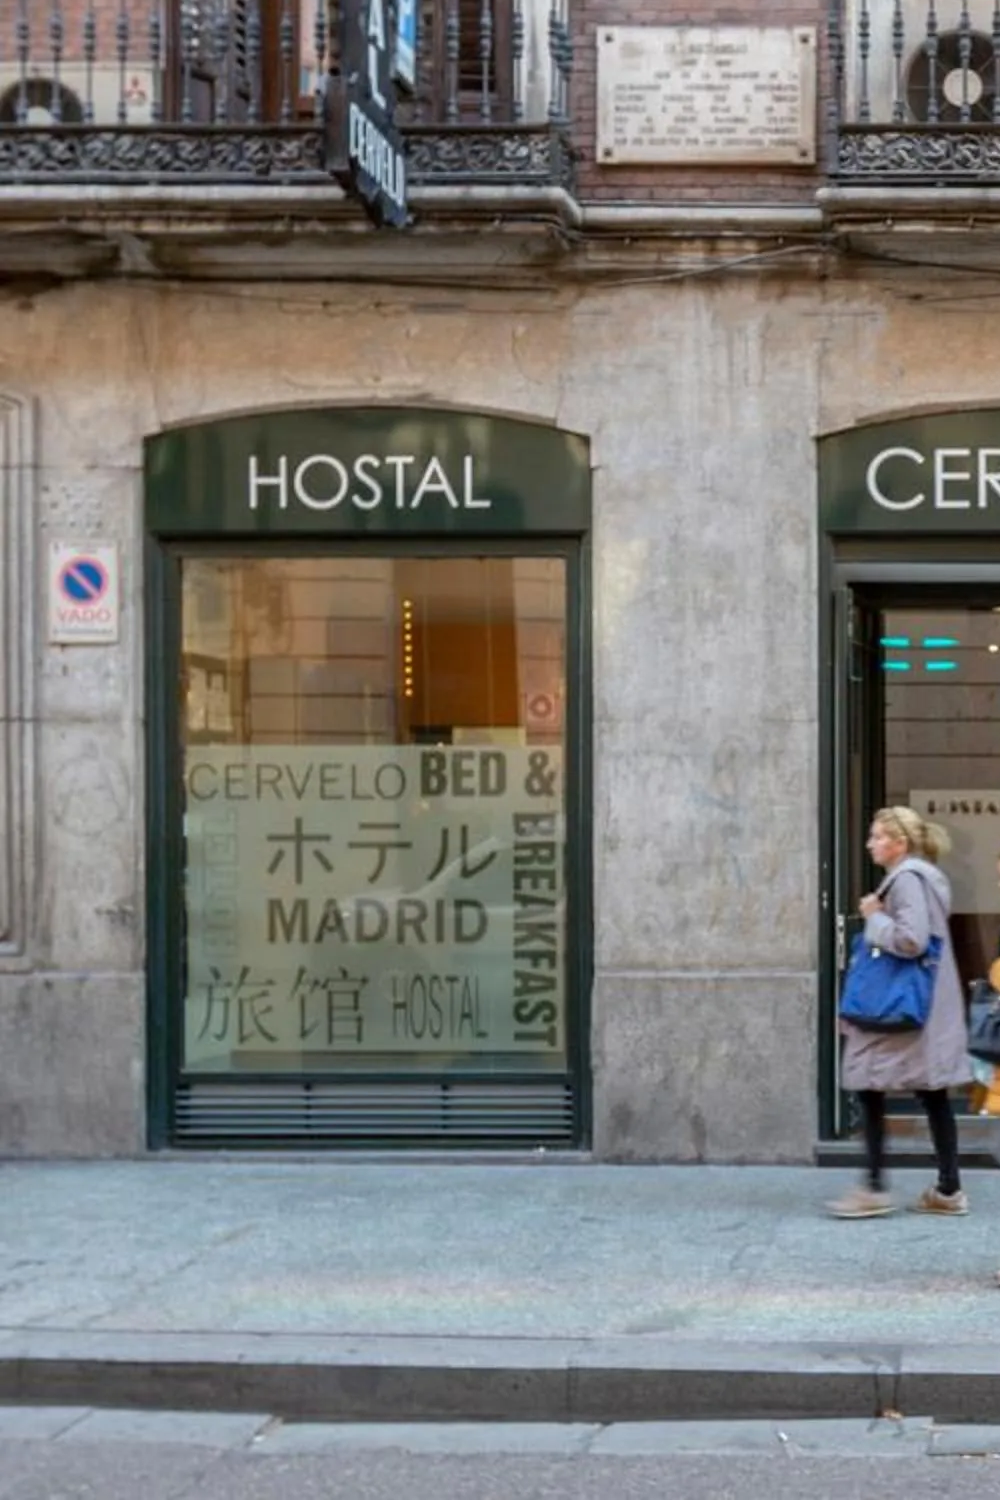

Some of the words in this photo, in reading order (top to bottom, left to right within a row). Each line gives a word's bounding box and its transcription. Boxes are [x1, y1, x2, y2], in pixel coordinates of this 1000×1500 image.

[248, 454, 492, 510] HOSTAL
[187, 762, 407, 801] CERVELO
[420, 750, 507, 797] BED
[525, 750, 557, 798] &
[266, 816, 497, 885] ホテル
[267, 898, 489, 945] MADRID
[512, 811, 558, 1047] BREAKFAST
[196, 965, 370, 1045] 旅馆
[391, 973, 489, 1040] HOSTAL
